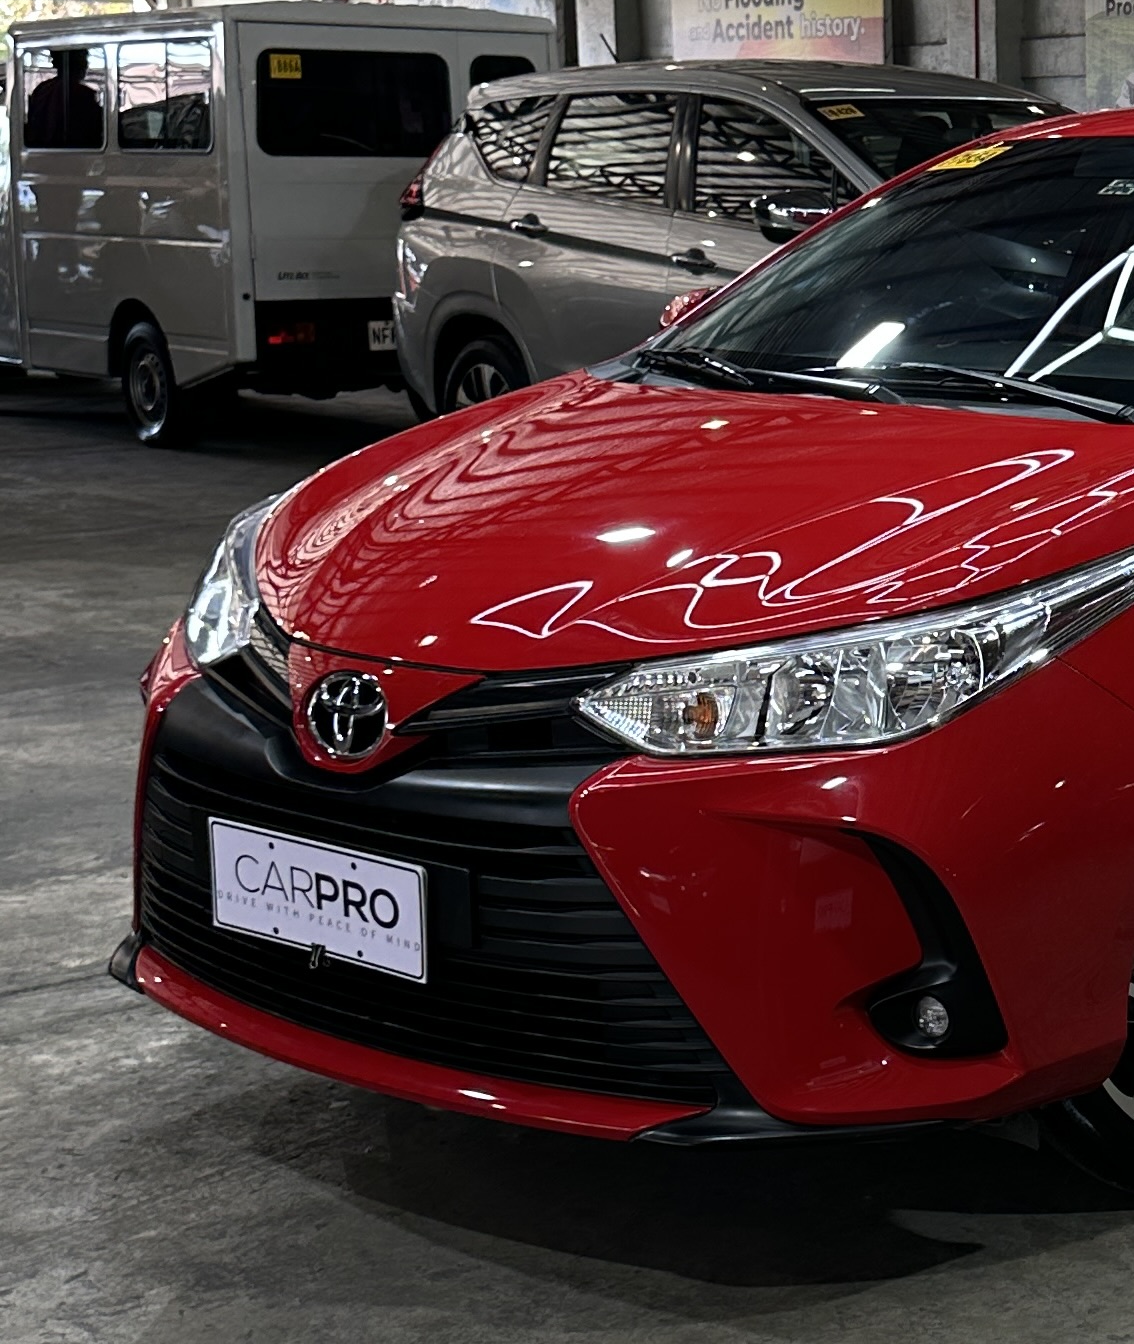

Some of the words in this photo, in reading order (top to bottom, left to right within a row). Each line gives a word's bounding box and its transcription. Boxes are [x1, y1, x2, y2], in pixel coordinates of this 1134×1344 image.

[712, 13, 794, 43] Accident
[801, 10, 866, 41] history.
[372, 328, 395, 344] NF
[235, 854, 399, 929] CARPRO
[217, 889, 257, 908] DRIVE
[266, 902, 300, 919] WITH
[309, 915, 352, 934] PEACE
[361, 927, 377, 938] OF
[386, 934, 420, 952] MIND
